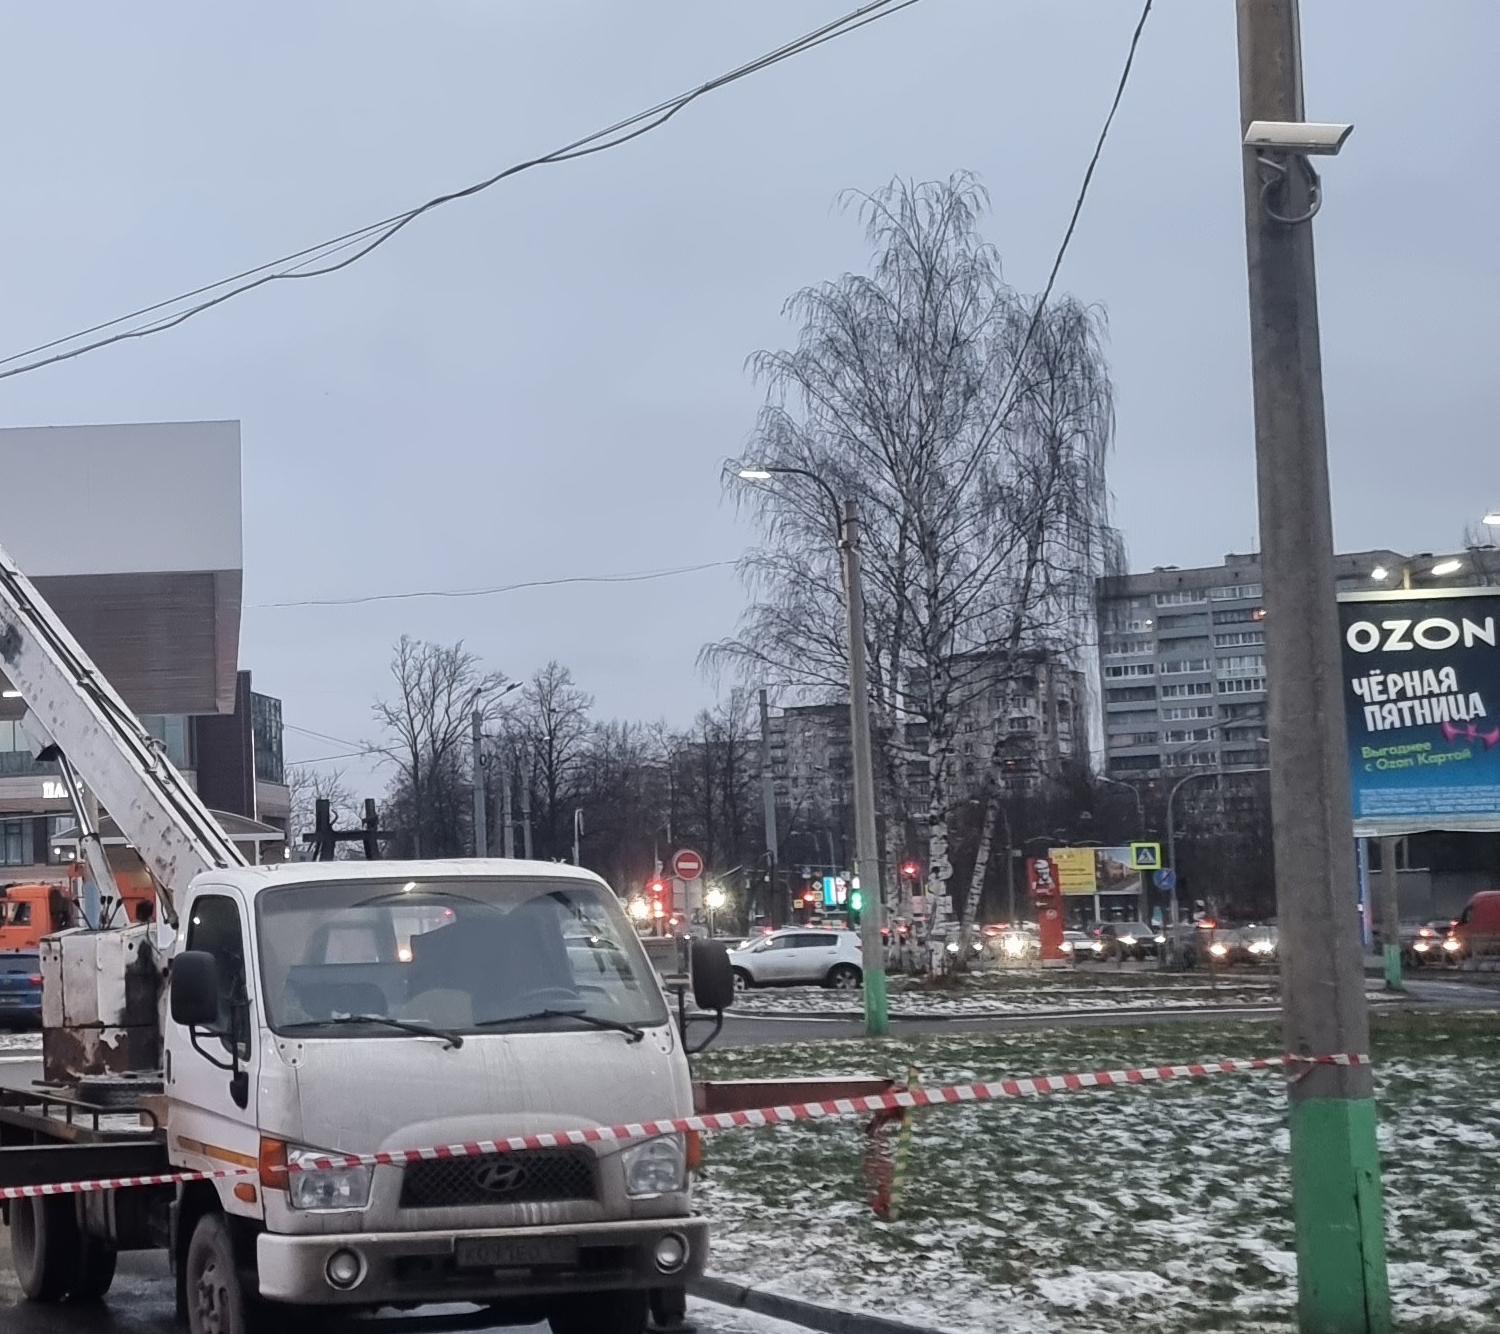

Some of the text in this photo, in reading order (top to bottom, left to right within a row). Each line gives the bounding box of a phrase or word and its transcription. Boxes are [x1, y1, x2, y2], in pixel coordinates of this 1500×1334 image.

[1346, 616, 1496, 653] OZON
[1351, 666, 1459, 703] ЧЁРНАЯ
[1363, 692, 1488, 732] ПЯТНИЦА
[1361, 742, 1432, 759] Выгоднее
[1376, 758, 1414, 770] Ozon
[1417, 748, 1472, 766] Картой
